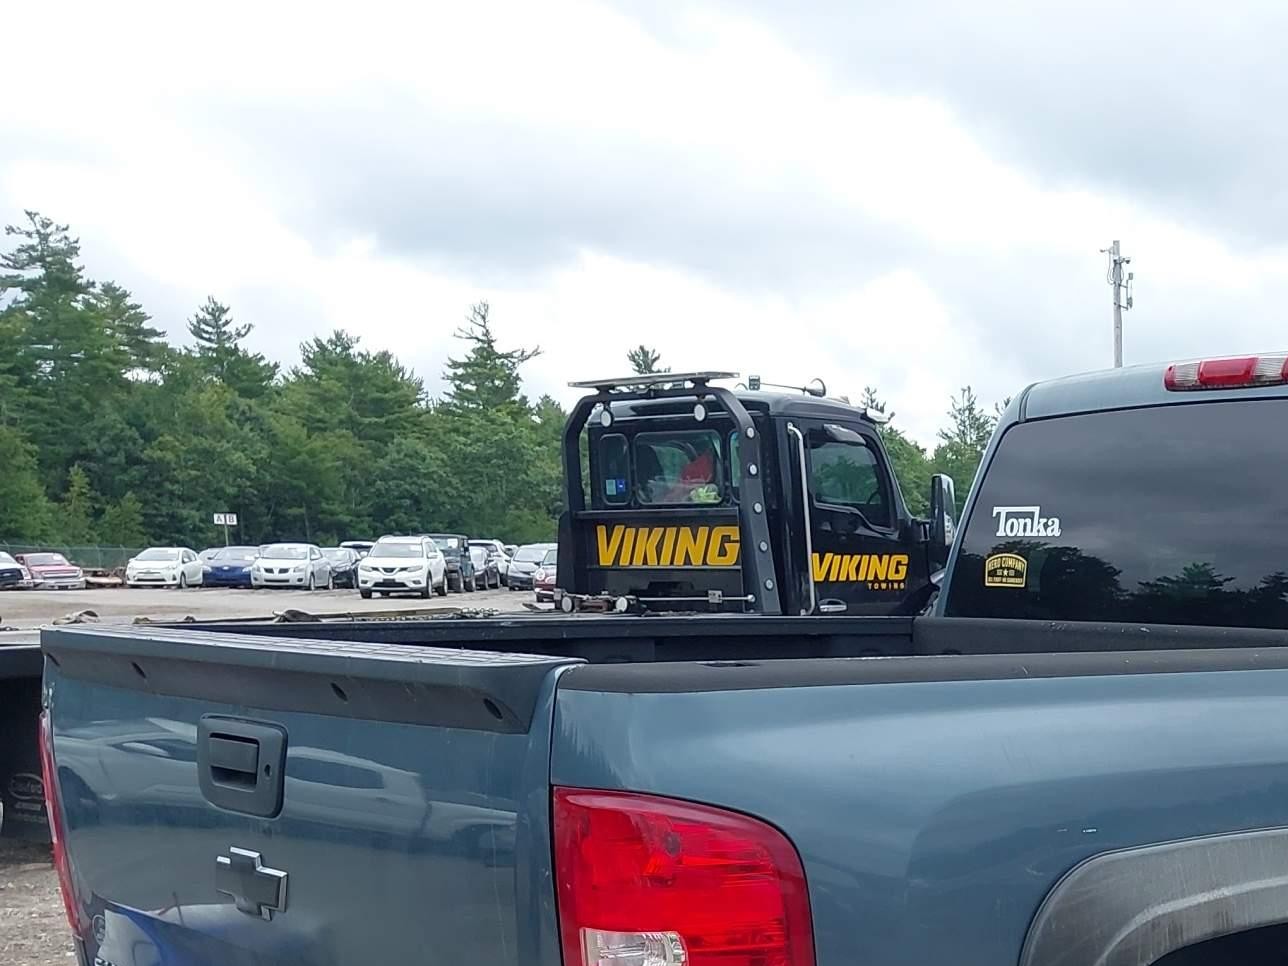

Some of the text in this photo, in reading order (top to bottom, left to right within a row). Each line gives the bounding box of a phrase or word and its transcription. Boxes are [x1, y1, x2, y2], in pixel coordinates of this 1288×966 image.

[992, 505, 1062, 537] Tonka
[596, 525, 740, 567] VIKING
[811, 552, 909, 582] VIKING
[1001, 556, 1025, 572] COMPANY
[867, 582, 905, 590] TOWING
